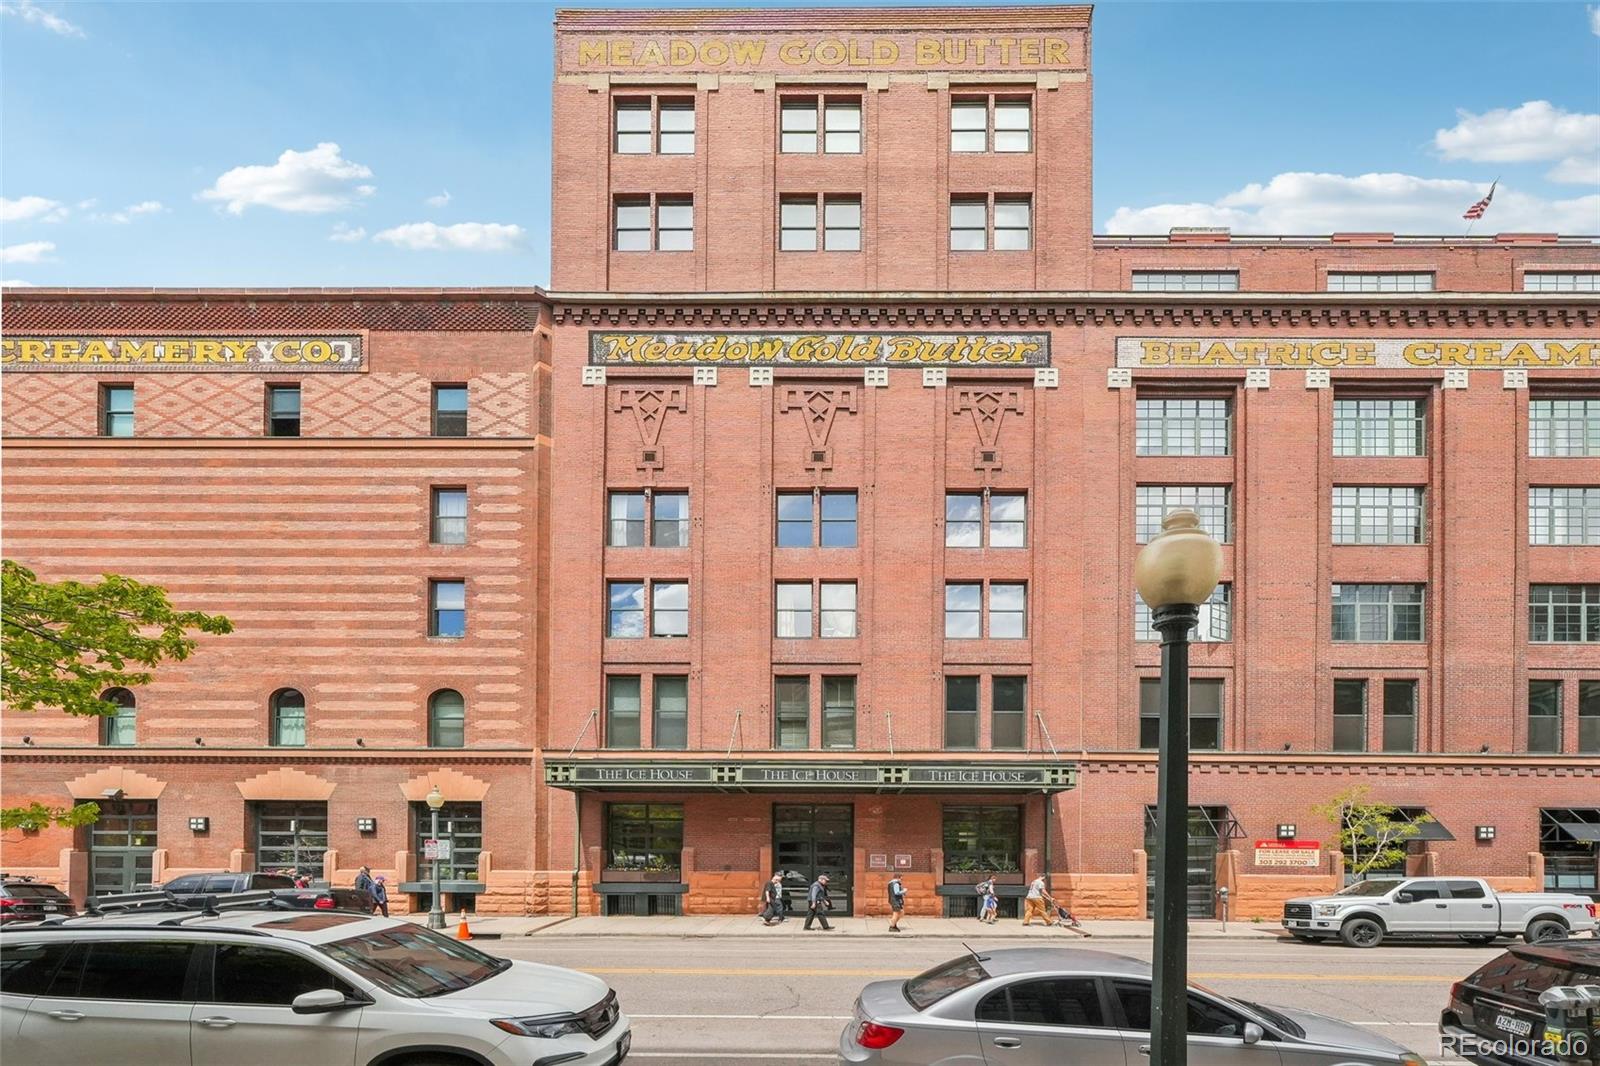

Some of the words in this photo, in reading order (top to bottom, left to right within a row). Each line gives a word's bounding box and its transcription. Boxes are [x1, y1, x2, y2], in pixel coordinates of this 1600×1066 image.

[578, 39, 766, 67] MEADOW
[779, 38, 900, 66] GOLD
[915, 38, 1071, 66] BUTTER
[602, 335, 783, 363] Meadow
[788, 335, 883, 363] Gold
[886, 335, 1040, 363] Butter
[1140, 341, 1377, 367] BEATRICE
[1402, 342, 1600, 367] CREAM
[595, 768, 622, 779] THE
[626, 768, 647, 779] ICE
[650, 768, 693, 780] HOUSE
[761, 769, 789, 780] THE
[792, 769, 814, 780] ICE
[816, 769, 859, 780] HOUSE
[928, 770, 956, 781] THE
[959, 770, 979, 781] ICE
[982, 770, 1025, 781] HOUSE
